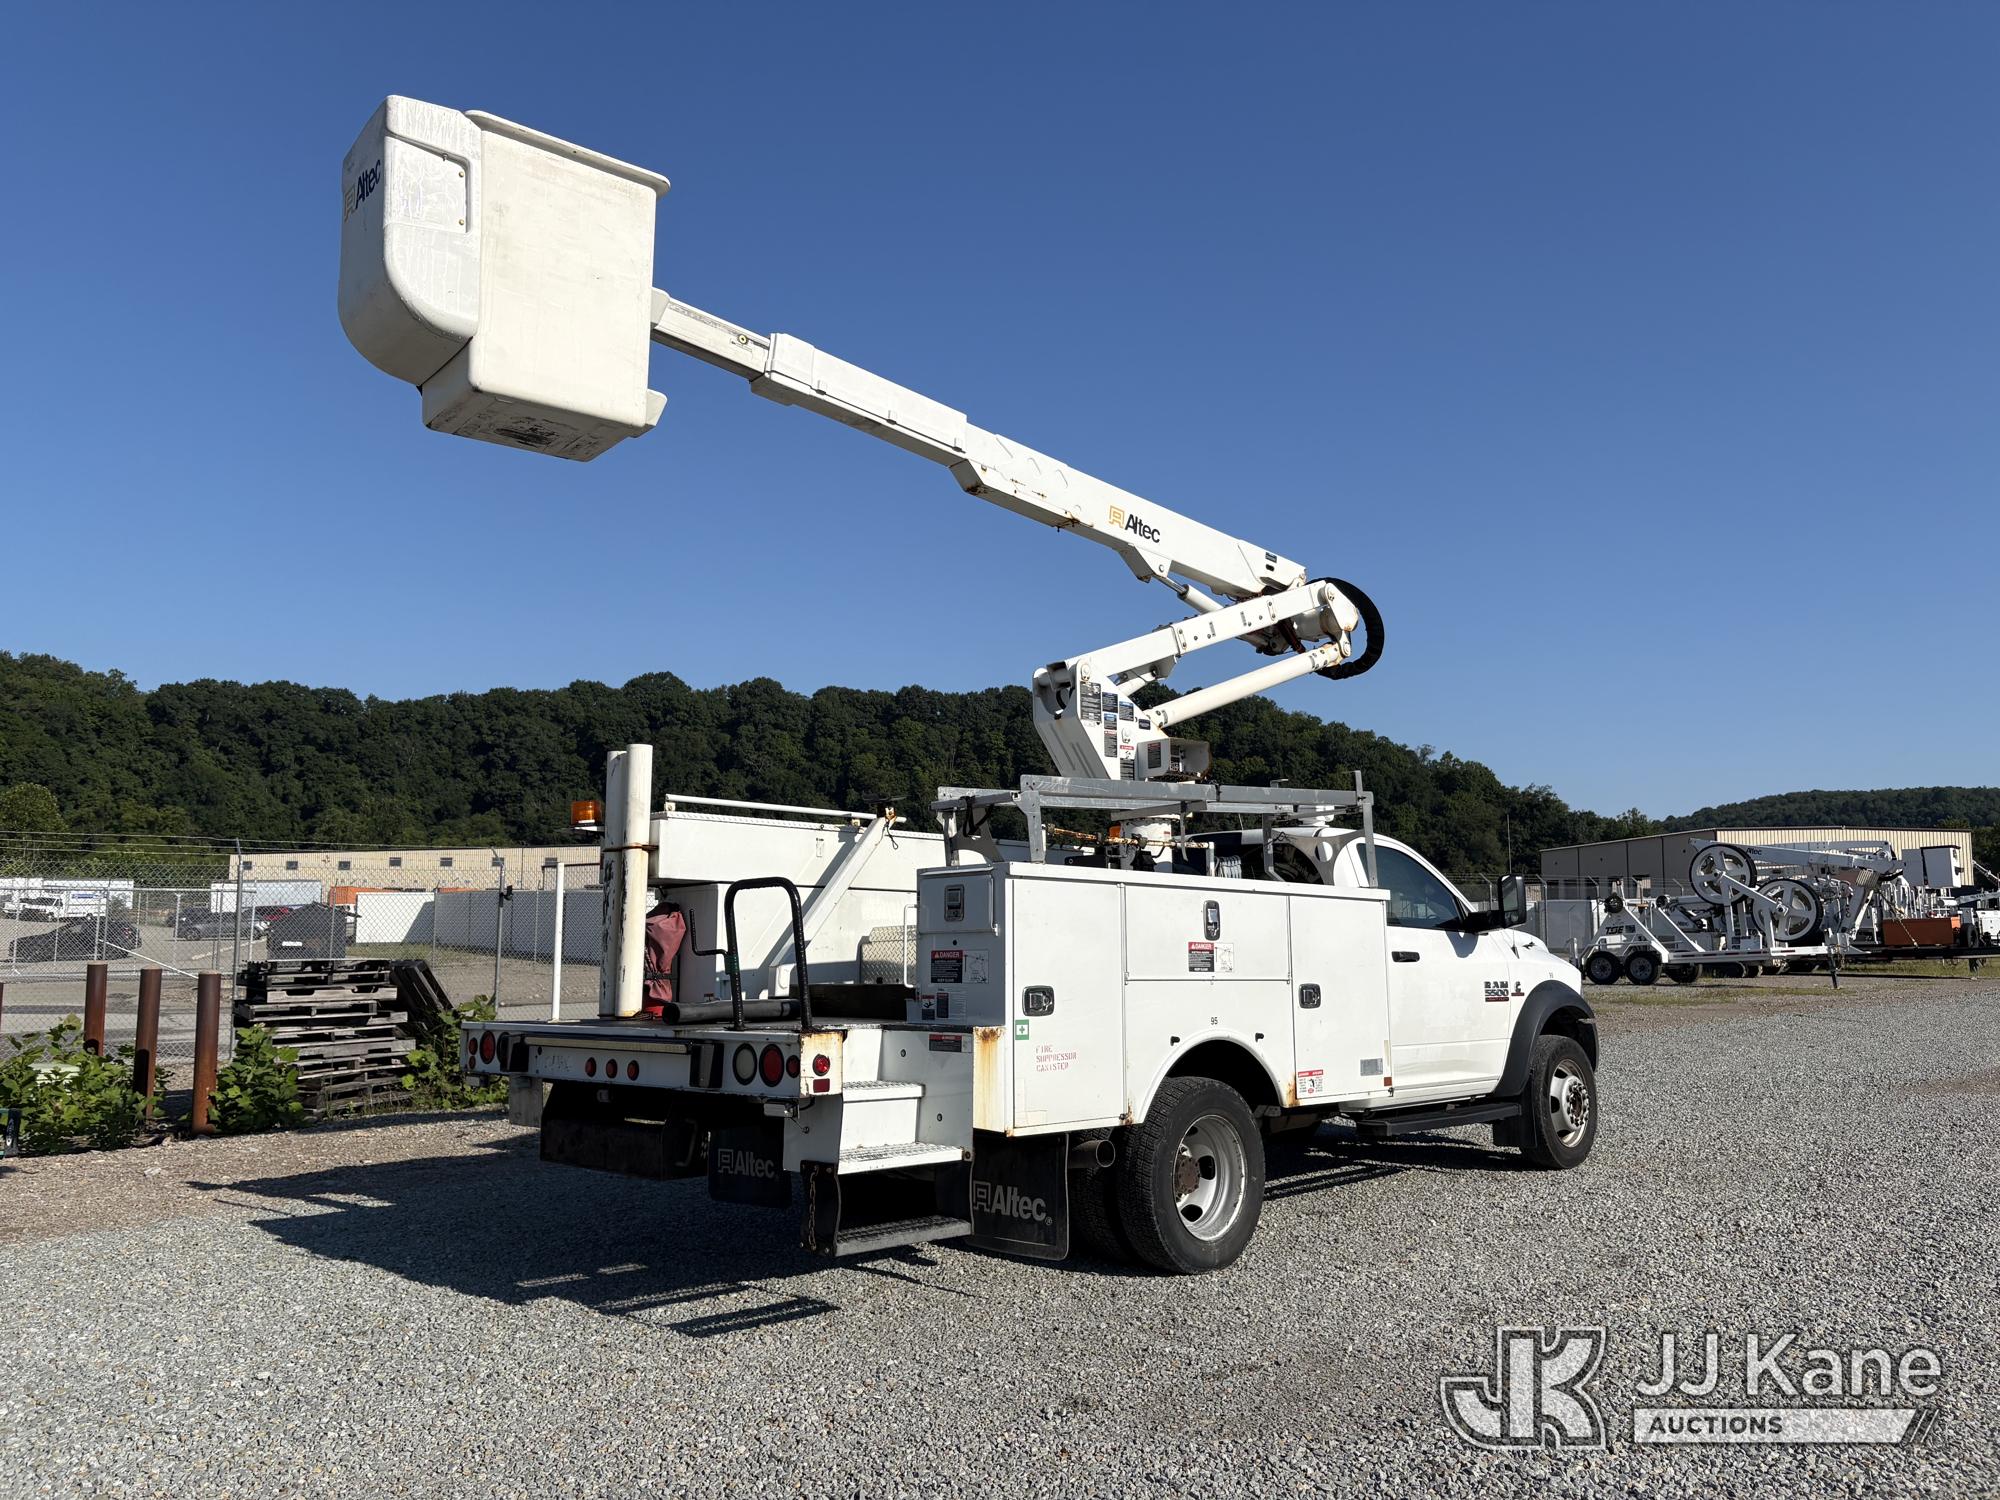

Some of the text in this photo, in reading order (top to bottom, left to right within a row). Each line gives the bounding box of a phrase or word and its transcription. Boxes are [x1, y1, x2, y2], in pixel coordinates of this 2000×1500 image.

[355, 159, 382, 210] Altec
[1124, 513, 1161, 543] Altec
[939, 951, 960, 959] DANGER
[1484, 981, 1509, 989] RAM
[1485, 989, 1509, 997] 5500
[1210, 1016, 1219, 1026] 95
[1036, 1051, 1077, 1063] SUPPRESSOR
[734, 1150, 775, 1178] Altec
